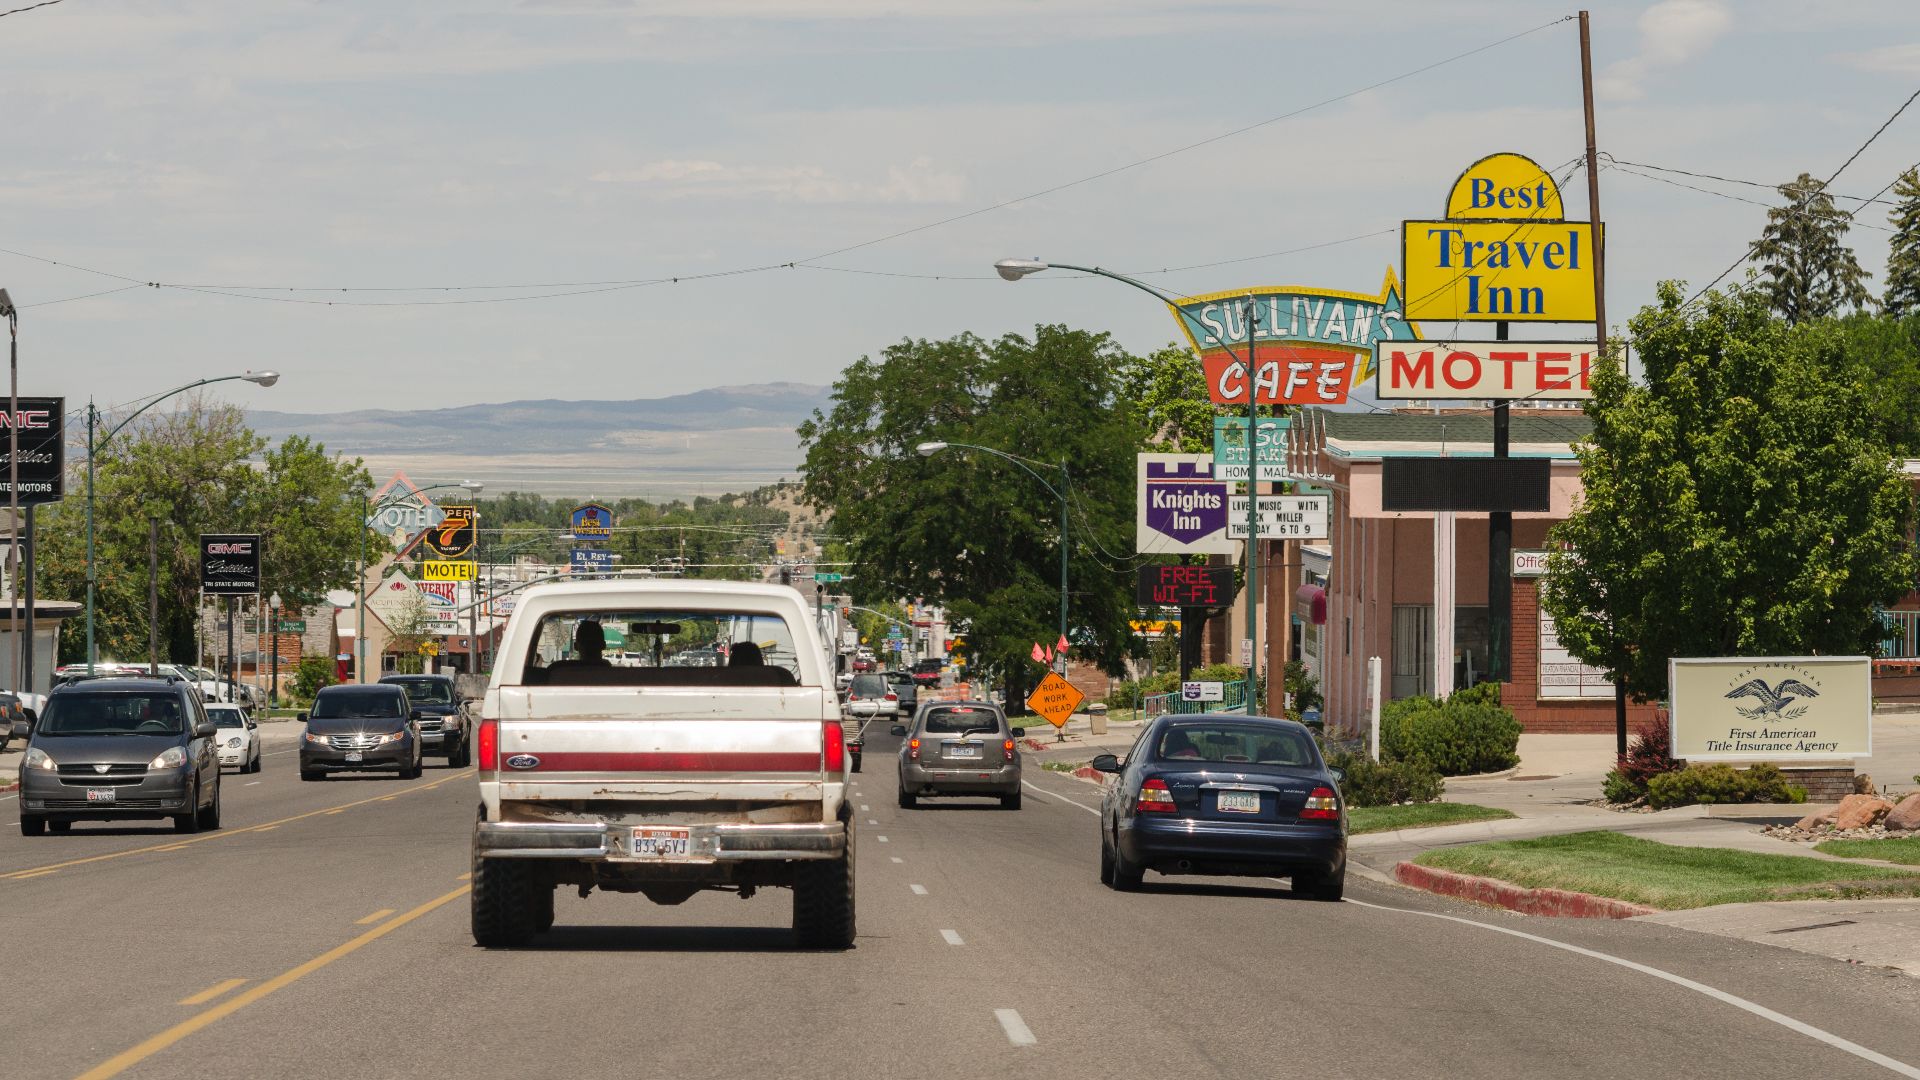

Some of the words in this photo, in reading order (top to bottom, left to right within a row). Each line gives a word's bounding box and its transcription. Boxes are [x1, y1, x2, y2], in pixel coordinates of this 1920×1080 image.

[1470, 178, 1549, 209] Best
[1428, 229, 1581, 270] Travel
[1464, 275, 1546, 315] Inn
[1200, 296, 1400, 346] SULLIVAN'S
[1219, 361, 1346, 400] CAFE
[1225, 467, 1250, 477] HOM
[17, 483, 52, 492] MOTORS
[1152, 489, 1222, 513] Knights
[1258, 501, 1282, 511] MUSIC
[1297, 501, 1319, 511] WITH
[444, 510, 472, 519] PER
[1173, 511, 1201, 530] Inn
[1276, 513, 1303, 522] MILLER
[581, 517, 601, 527] Best
[574, 526, 610, 537] Western
[1232, 525, 1271, 534] THURDAY
[1280, 524, 1286, 534] 6
[1290, 524, 1299, 534] TO
[1304, 524, 1311, 534] 9
[208, 543, 252, 554] GMC
[576, 552, 588, 561] EL
[590, 552, 607, 561] REY
[1516, 556, 1545, 569] Offic
[426, 564, 473, 578] MOTEL
[1160, 566, 1212, 584] FREE
[415, 582, 456, 605] VERIK
[1153, 585, 1217, 604] WI-FI
[1729, 665, 1758, 687] FIRST
[1765, 662, 1822, 687] AMERICAN
[1042, 682, 1066, 692] ROAD
[1044, 694, 1068, 703] WORK
[1044, 703, 1072, 714] AHEAD
[1728, 728, 1757, 739] First
[1759, 727, 1817, 738] American
[1706, 740, 1733, 751] Title
[1735, 741, 1793, 751] Insurance
[1795, 740, 1839, 753] Agency
[513, 756, 532, 767] Ford
[635, 838, 657, 854] B33
